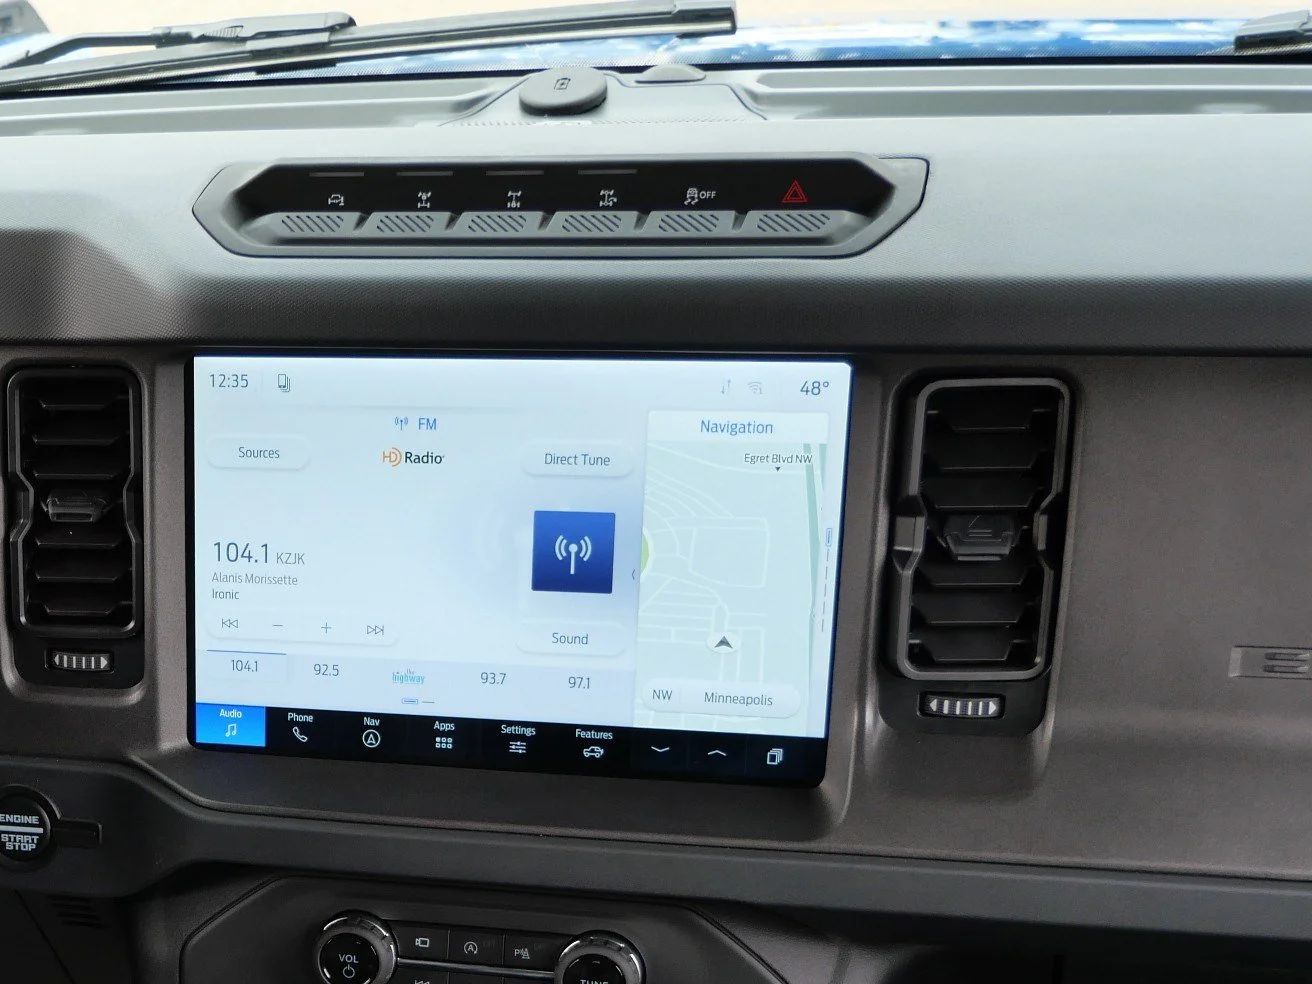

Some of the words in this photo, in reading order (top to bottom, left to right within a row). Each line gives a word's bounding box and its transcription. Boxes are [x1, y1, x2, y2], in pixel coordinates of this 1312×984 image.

[698, 190, 717, 199] OFF
[208, 373, 250, 389] 12:35
[417, 417, 438, 431] FM
[700, 418, 774, 437] Navigation
[238, 446, 281, 460] Sources
[404, 450, 445, 466] Radio
[544, 452, 578, 467] Direct
[581, 453, 611, 467] Tune
[744, 452, 770, 465] Egret
[772, 452, 794, 464] Blvd
[795, 453, 813, 465] NW
[213, 541, 270, 564] 104.1
[275, 551, 306, 566] KZJK
[211, 571, 243, 584] Alanis
[244, 573, 299, 586] Morissette
[211, 588, 240, 600] Ironic
[551, 632, 589, 646] Sound
[230, 659, 259, 673] 104.1
[313, 663, 340, 678] 92.5
[392, 671, 426, 685] highway
[480, 671, 507, 686] 93.7
[568, 676, 591, 690] 97.1
[651, 689, 673, 702] NW
[704, 691, 774, 708] Minneapolis
[219, 708, 243, 719] Audio
[287, 712, 314, 723] Phone
[363, 716, 381, 727] Nav
[433, 721, 456, 733] Apps
[501, 724, 537, 737] Settings
[575, 728, 613, 740] Features
[0, 833, 40, 845] START
[5, 842, 37, 852] STOP
[338, 953, 359, 964] VOL
